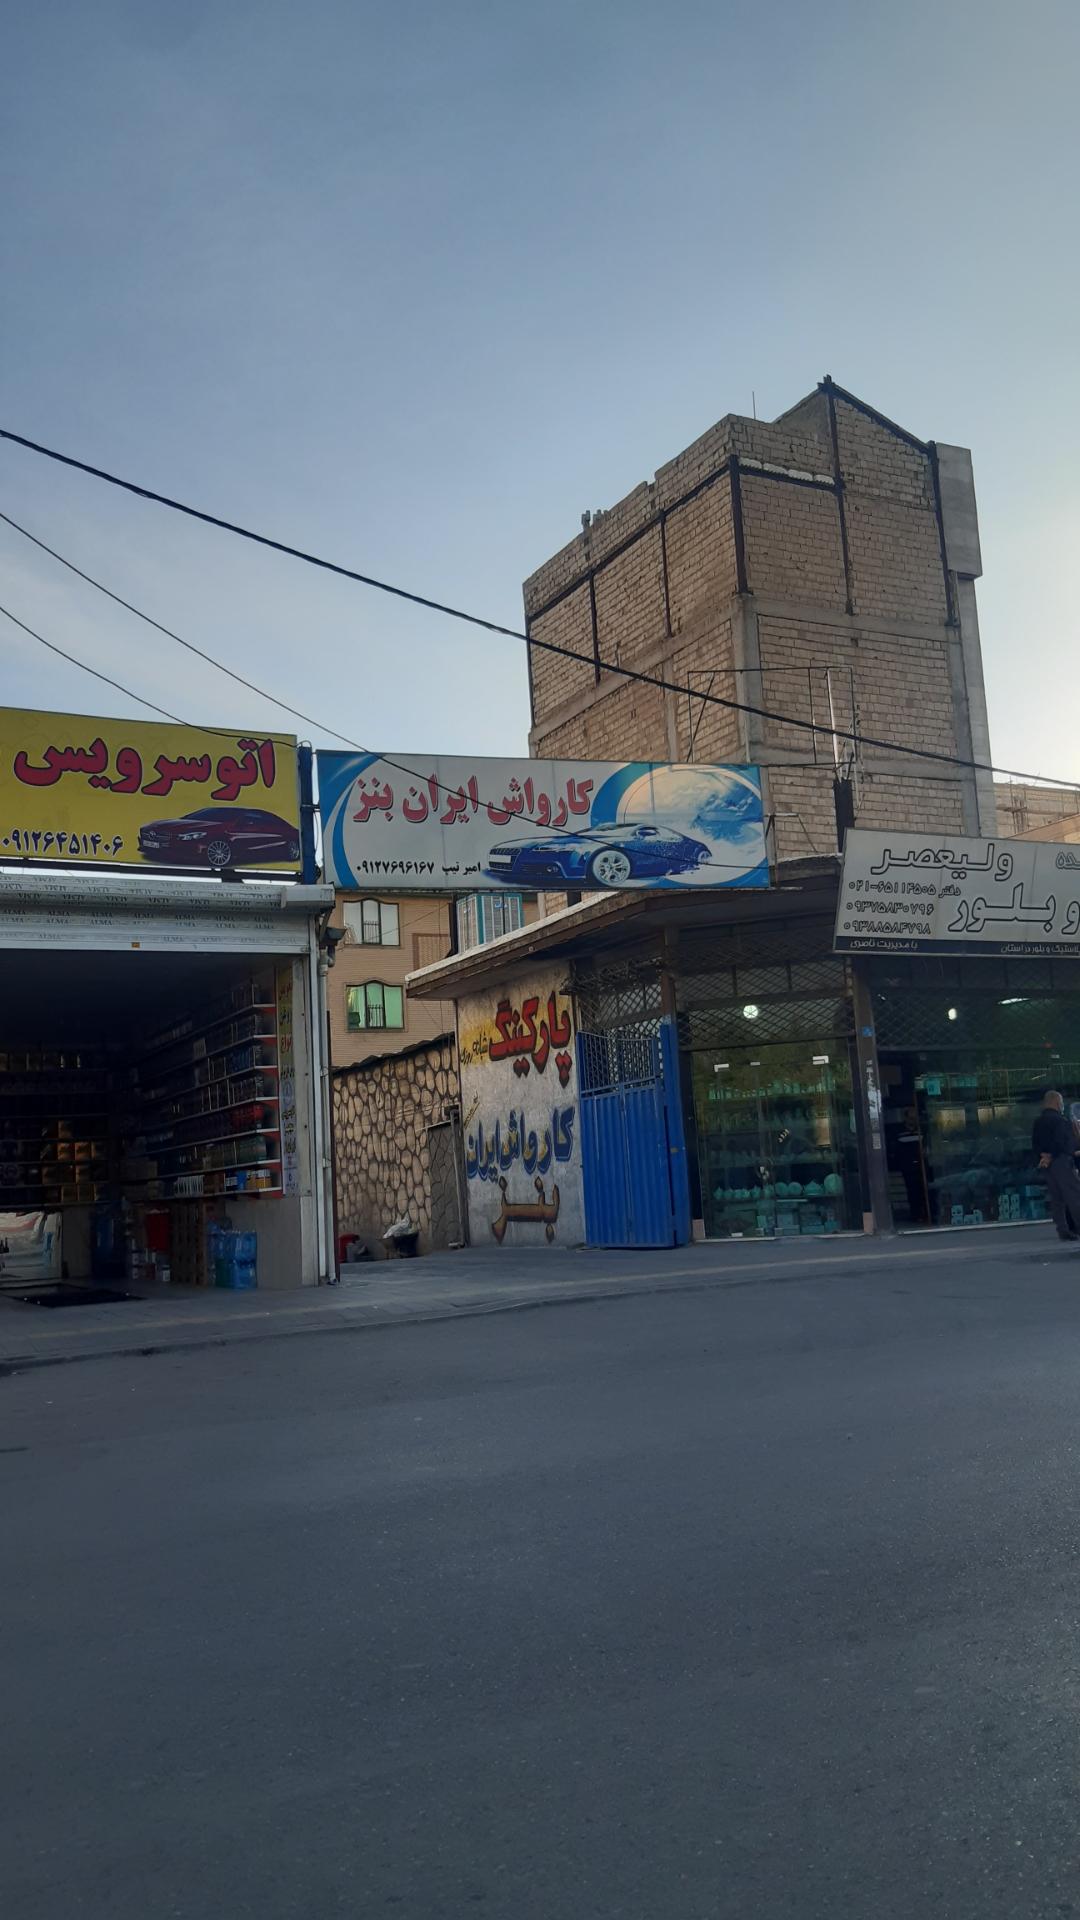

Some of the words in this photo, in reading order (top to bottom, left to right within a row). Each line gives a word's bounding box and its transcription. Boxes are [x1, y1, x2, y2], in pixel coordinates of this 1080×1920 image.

[353, 776, 395, 823] بنز
[401, 774, 480, 826] ایران
[487, 777, 594, 827] کارواش
[462, 861, 481, 876] امیر
[938, 885, 962, 898] دفتر
[948, 882, 1056, 934] بلور
[489, 990, 573, 1088] پارکینگ
[466, 1119, 501, 1184] ایران
[500, 1106, 576, 1175] کارواش
[491, 1175, 561, 1245] بنز
